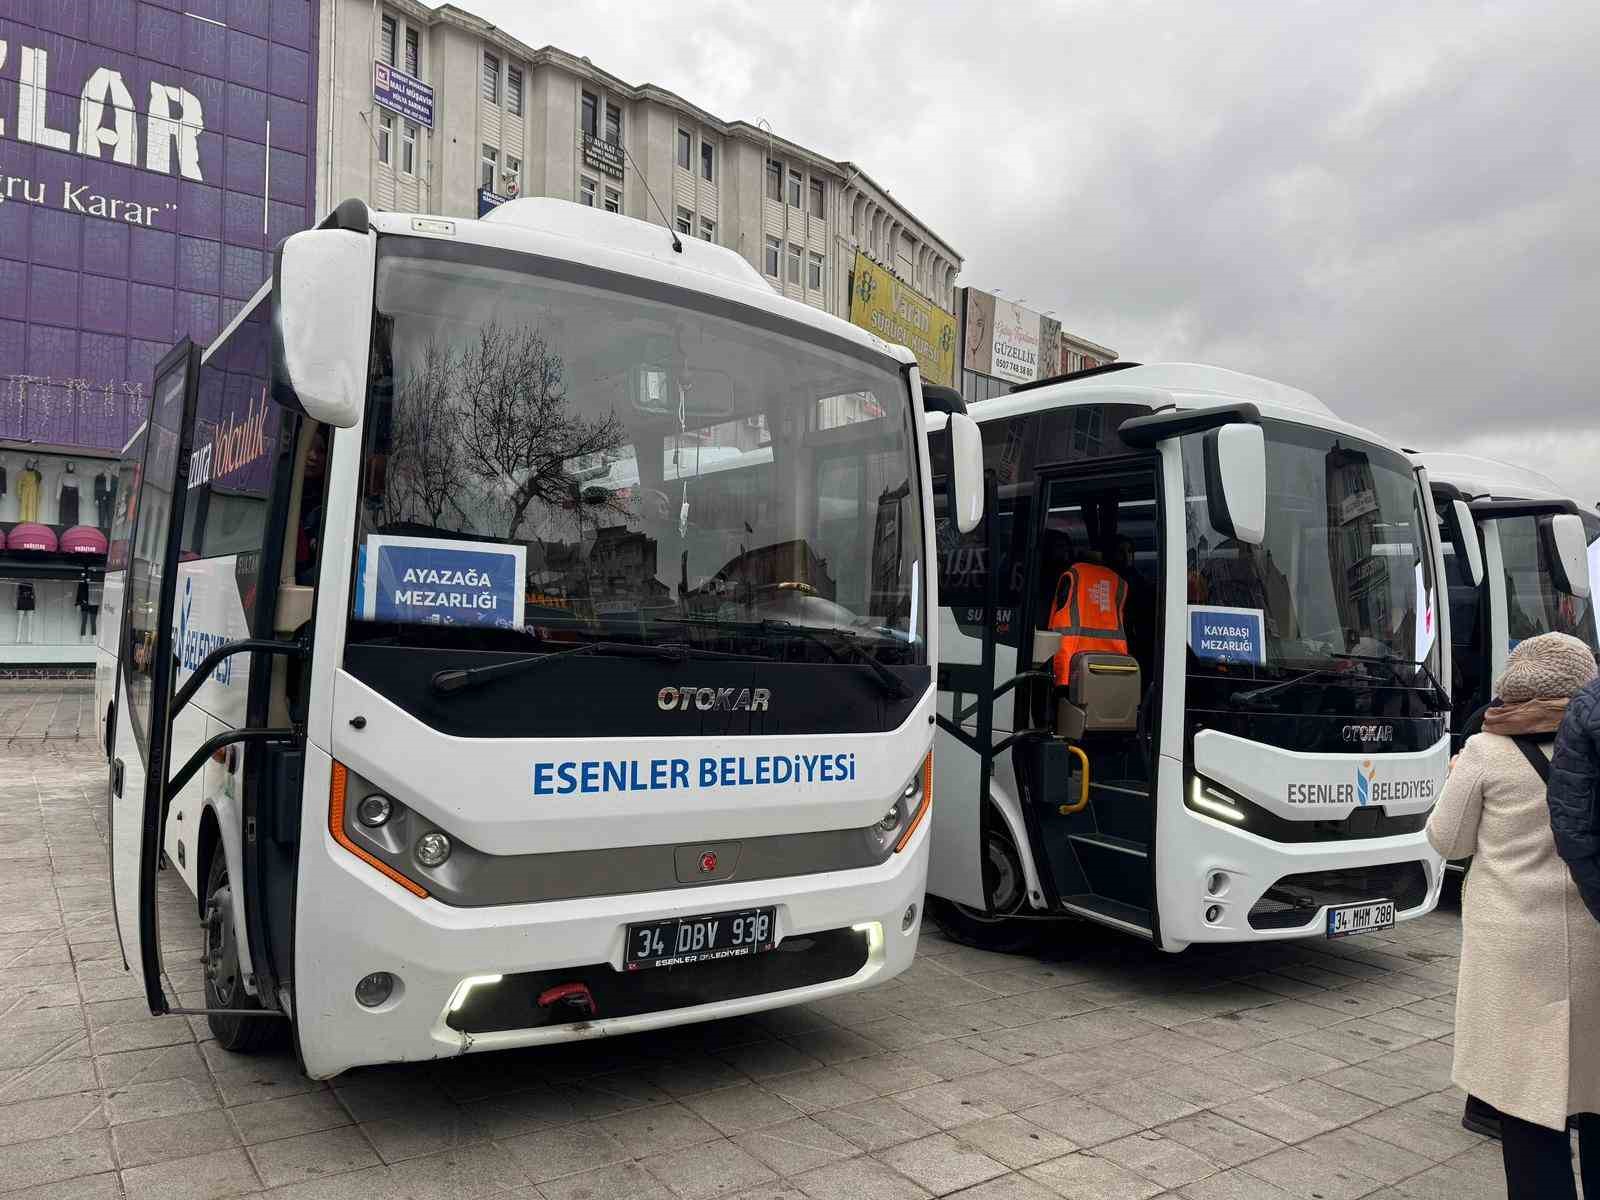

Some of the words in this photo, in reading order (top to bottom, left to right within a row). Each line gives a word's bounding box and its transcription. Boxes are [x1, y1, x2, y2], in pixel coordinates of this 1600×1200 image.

[0, 40, 204, 181] LAR
[0, 165, 45, 203] ru
[213, 387, 269, 480] Yolculuk
[403, 568, 491, 587] AYAZAĞA
[395, 590, 497, 609] MEZARLIĞI
[967, 608, 1012, 623] SUAN
[1204, 624, 1249, 639] KAYABAŞI
[1201, 639, 1253, 652] MEZARLIĞI
[657, 686, 770, 711] OTOKAR
[1342, 725, 1393, 742] OTOKAR
[534, 758, 689, 795] ESENLER
[1287, 783, 1354, 803] ESENLER
[1336, 911, 1347, 930] 34
[1353, 907, 1370, 928] MHM
[1375, 904, 1391, 924] 288
[638, 928, 664, 957] 34
[679, 920, 718, 952] DBV
[731, 915, 769, 944] 938
[655, 955, 697, 967] ESENLER
